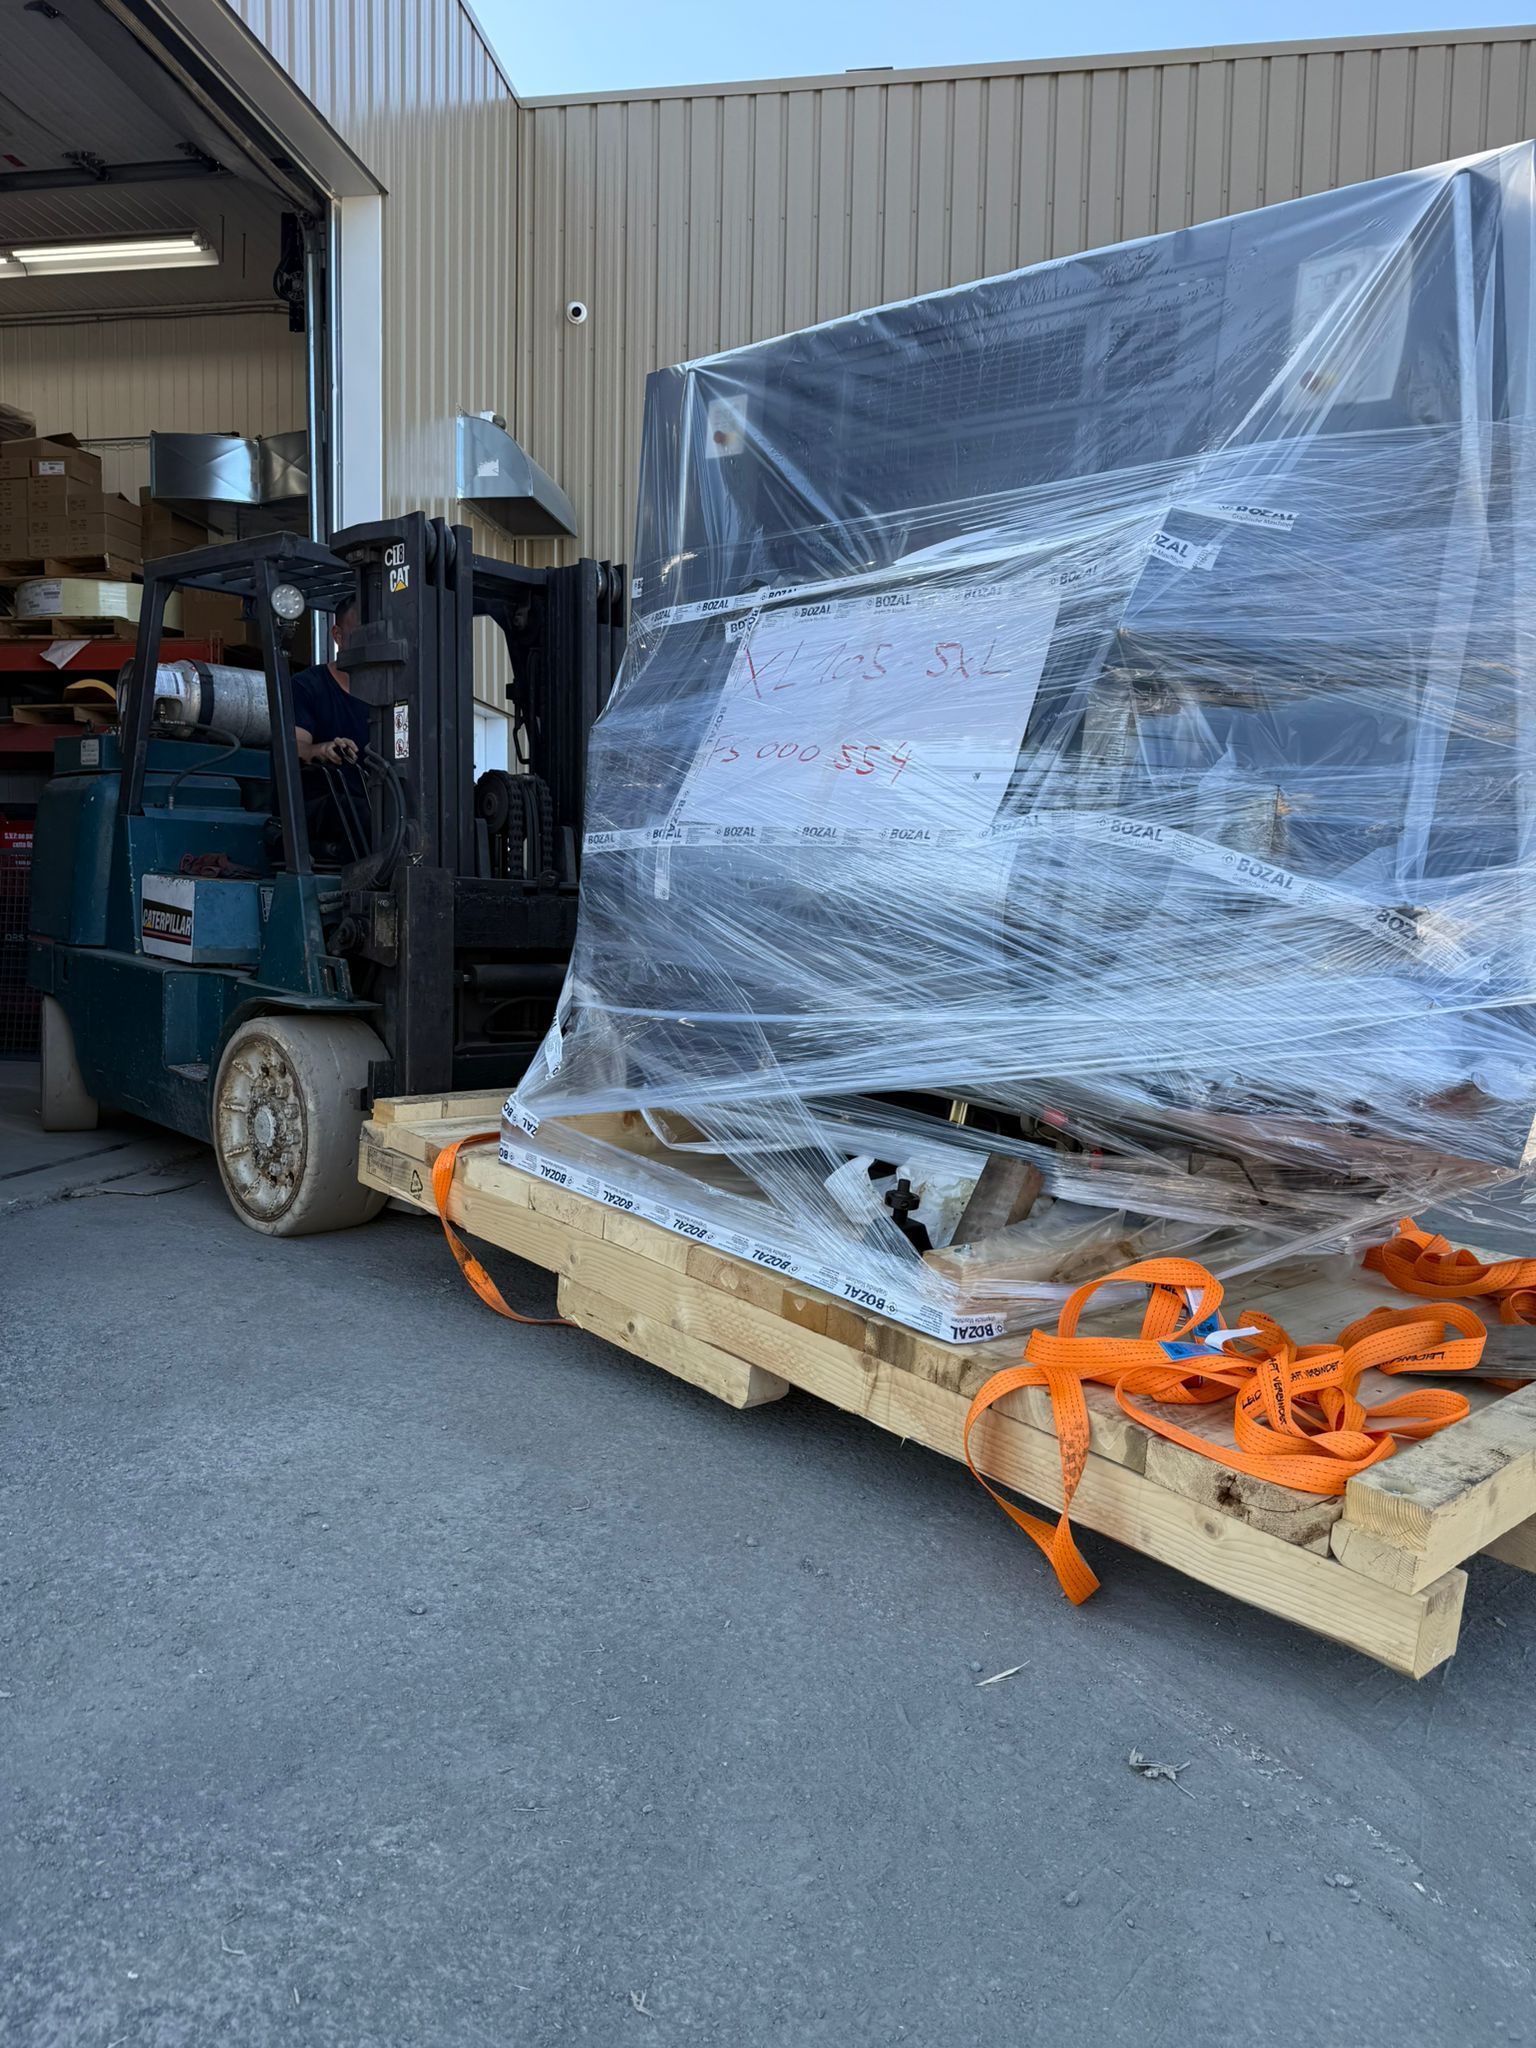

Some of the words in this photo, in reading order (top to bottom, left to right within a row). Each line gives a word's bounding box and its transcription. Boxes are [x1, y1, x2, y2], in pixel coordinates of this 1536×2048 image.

[390, 565, 410, 592] CAT
[652, 609, 672, 621] BOZAL
[702, 600, 729, 612] BOZAL
[800, 604, 832, 617] BOZAL
[875, 594, 911, 608] BOZAL
[588, 834, 615, 844] BOZAL
[723, 827, 757, 837] BOZAL
[801, 827, 837, 838] BOZAL
[889, 828, 931, 840] BOZAL
[1110, 820, 1164, 842] BOZAL
[1236, 858, 1294, 890] BOZAL
[143, 908, 192, 937] CATERPILLAR
[540, 1164, 567, 1184] BOZAL
[603, 1190, 634, 1210] BOZAL
[673, 1218, 708, 1239] BOZAL
[751, 1249, 792, 1270] BOZAL
[844, 1283, 886, 1310] BOZAL
[951, 1323, 994, 1340] BOZAL
